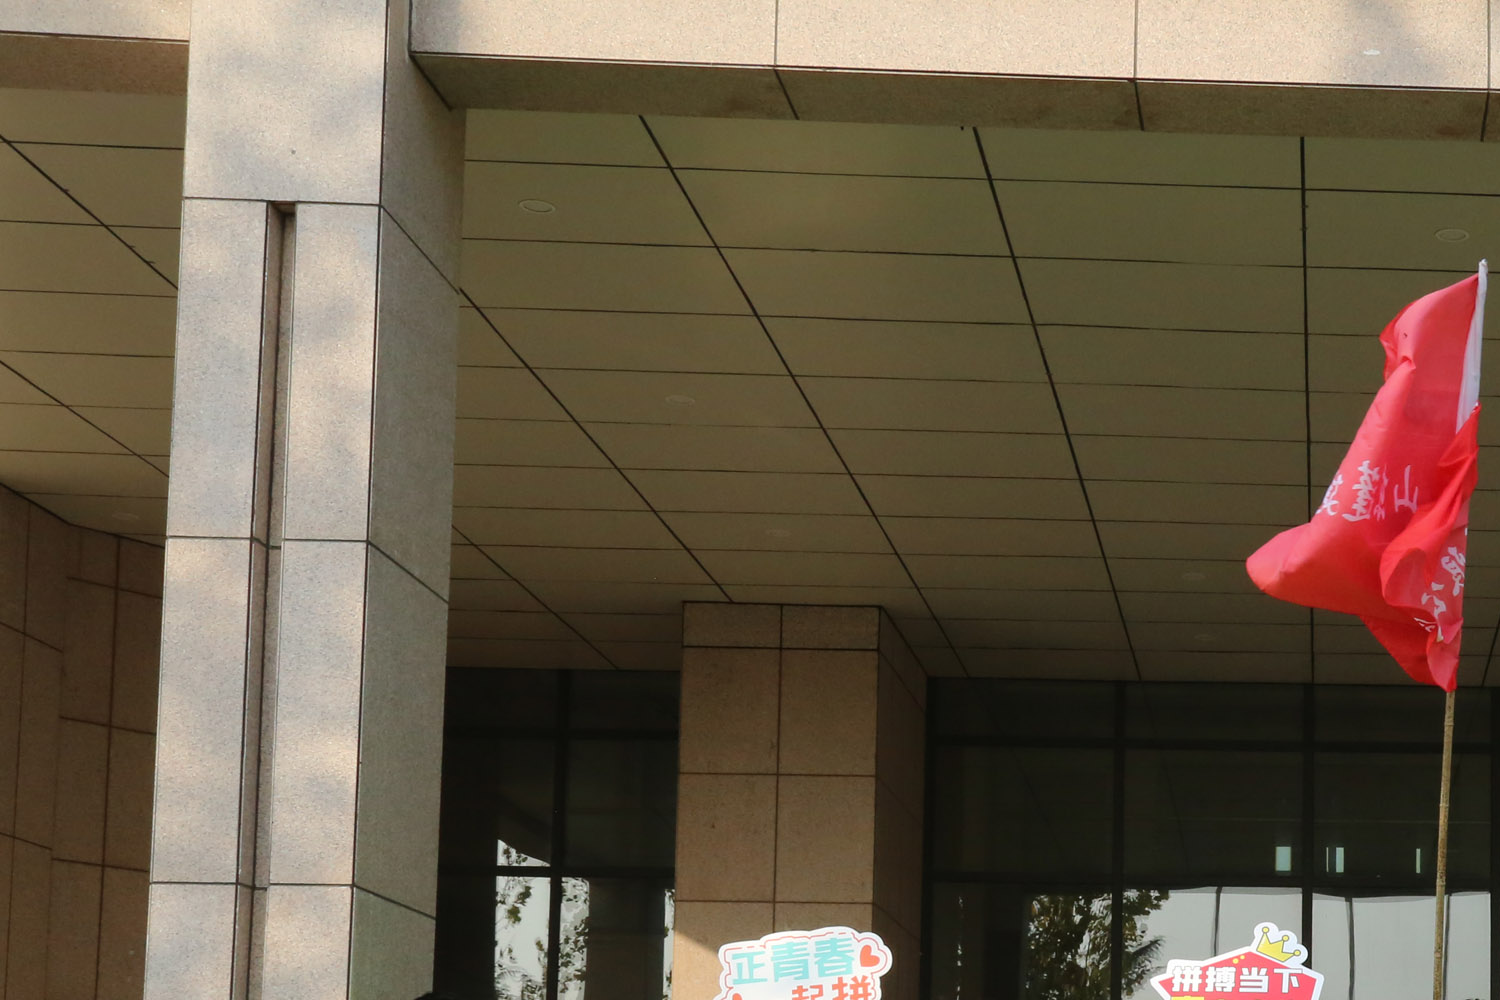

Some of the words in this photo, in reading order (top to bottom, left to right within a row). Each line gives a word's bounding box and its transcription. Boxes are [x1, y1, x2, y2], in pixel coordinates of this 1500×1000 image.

[731, 937, 855, 985] 正青春
[1171, 966, 1303, 993] 拼搏当下
